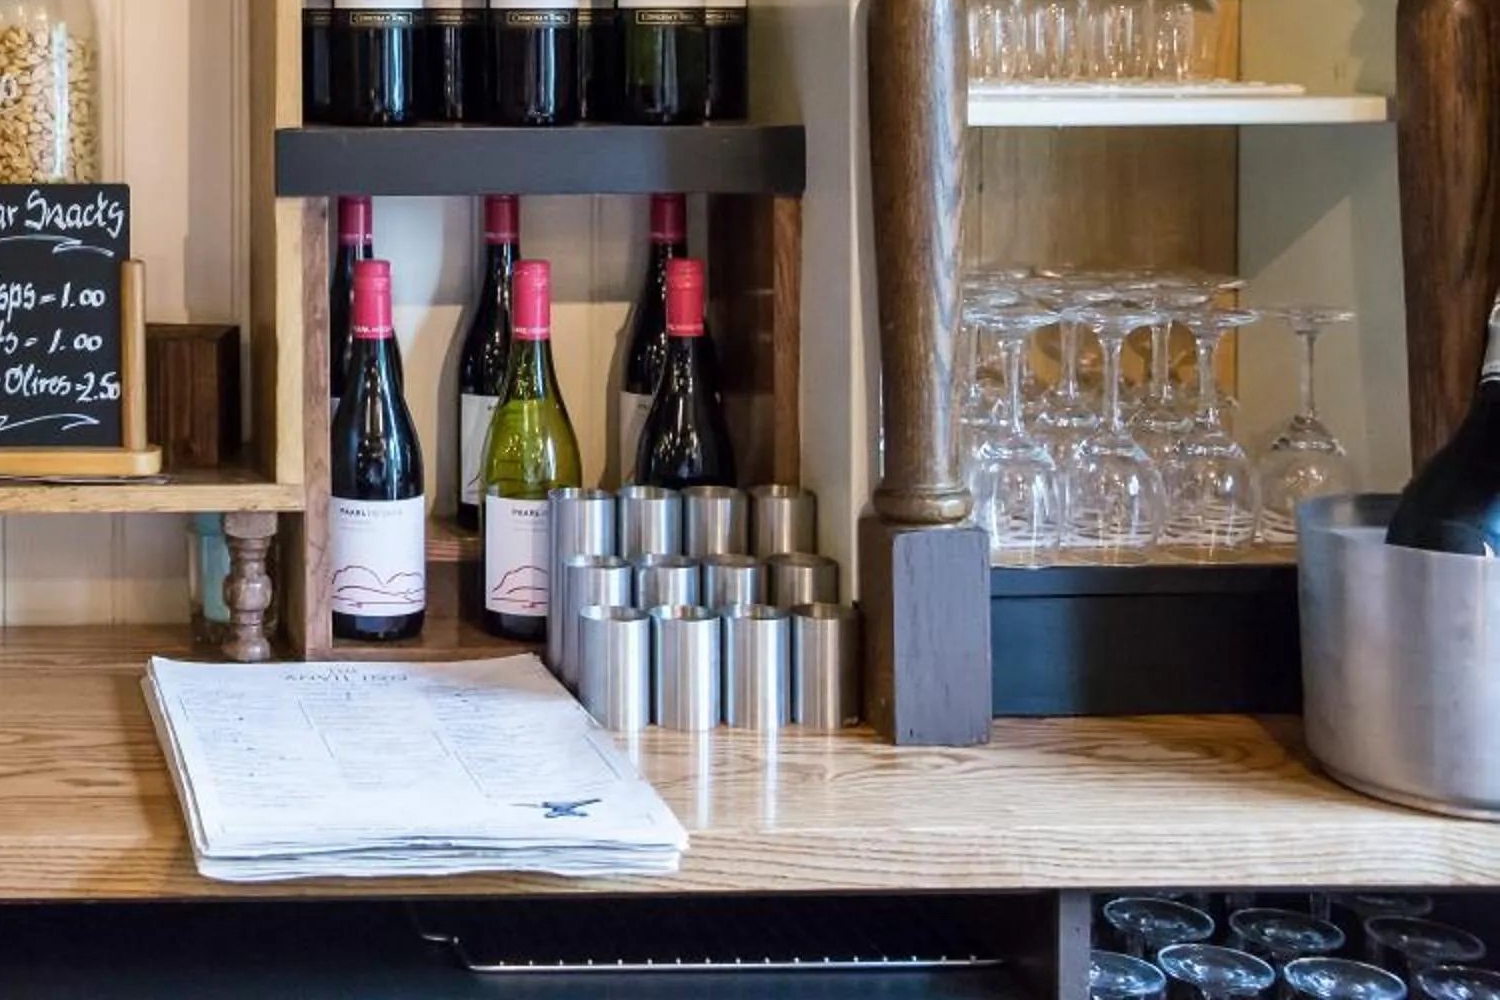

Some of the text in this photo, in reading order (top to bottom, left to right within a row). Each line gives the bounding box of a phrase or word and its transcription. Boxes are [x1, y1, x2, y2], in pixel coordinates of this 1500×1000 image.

[24, 189, 125, 239] Snacks
[60, 281, 106, 309] 1.00
[5, 363, 71, 397] Olives
